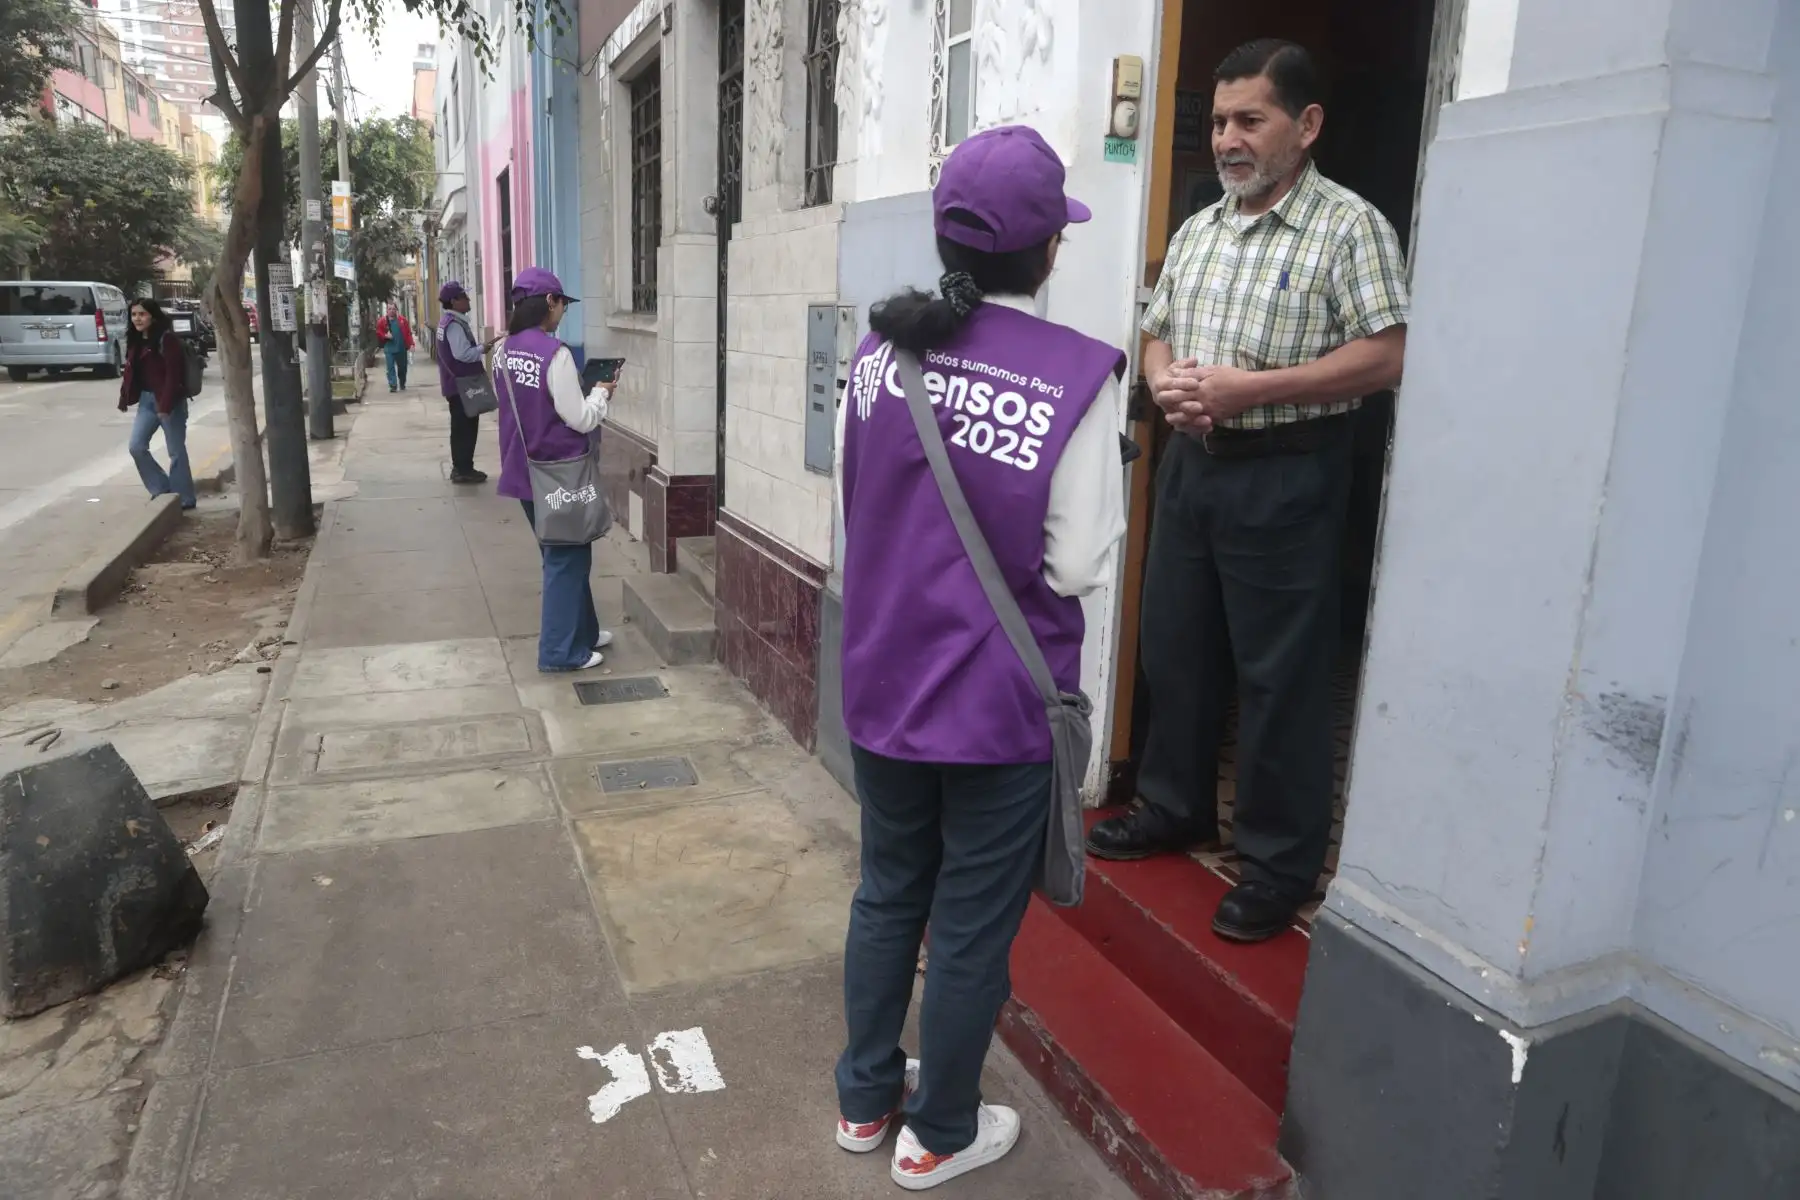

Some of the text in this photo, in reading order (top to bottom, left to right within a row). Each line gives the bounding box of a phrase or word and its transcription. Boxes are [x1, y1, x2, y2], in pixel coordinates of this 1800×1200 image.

[504, 354, 541, 376] ensos
[925, 349, 1065, 399] Todos sumamos Perú
[950, 414, 1044, 471] 2025
